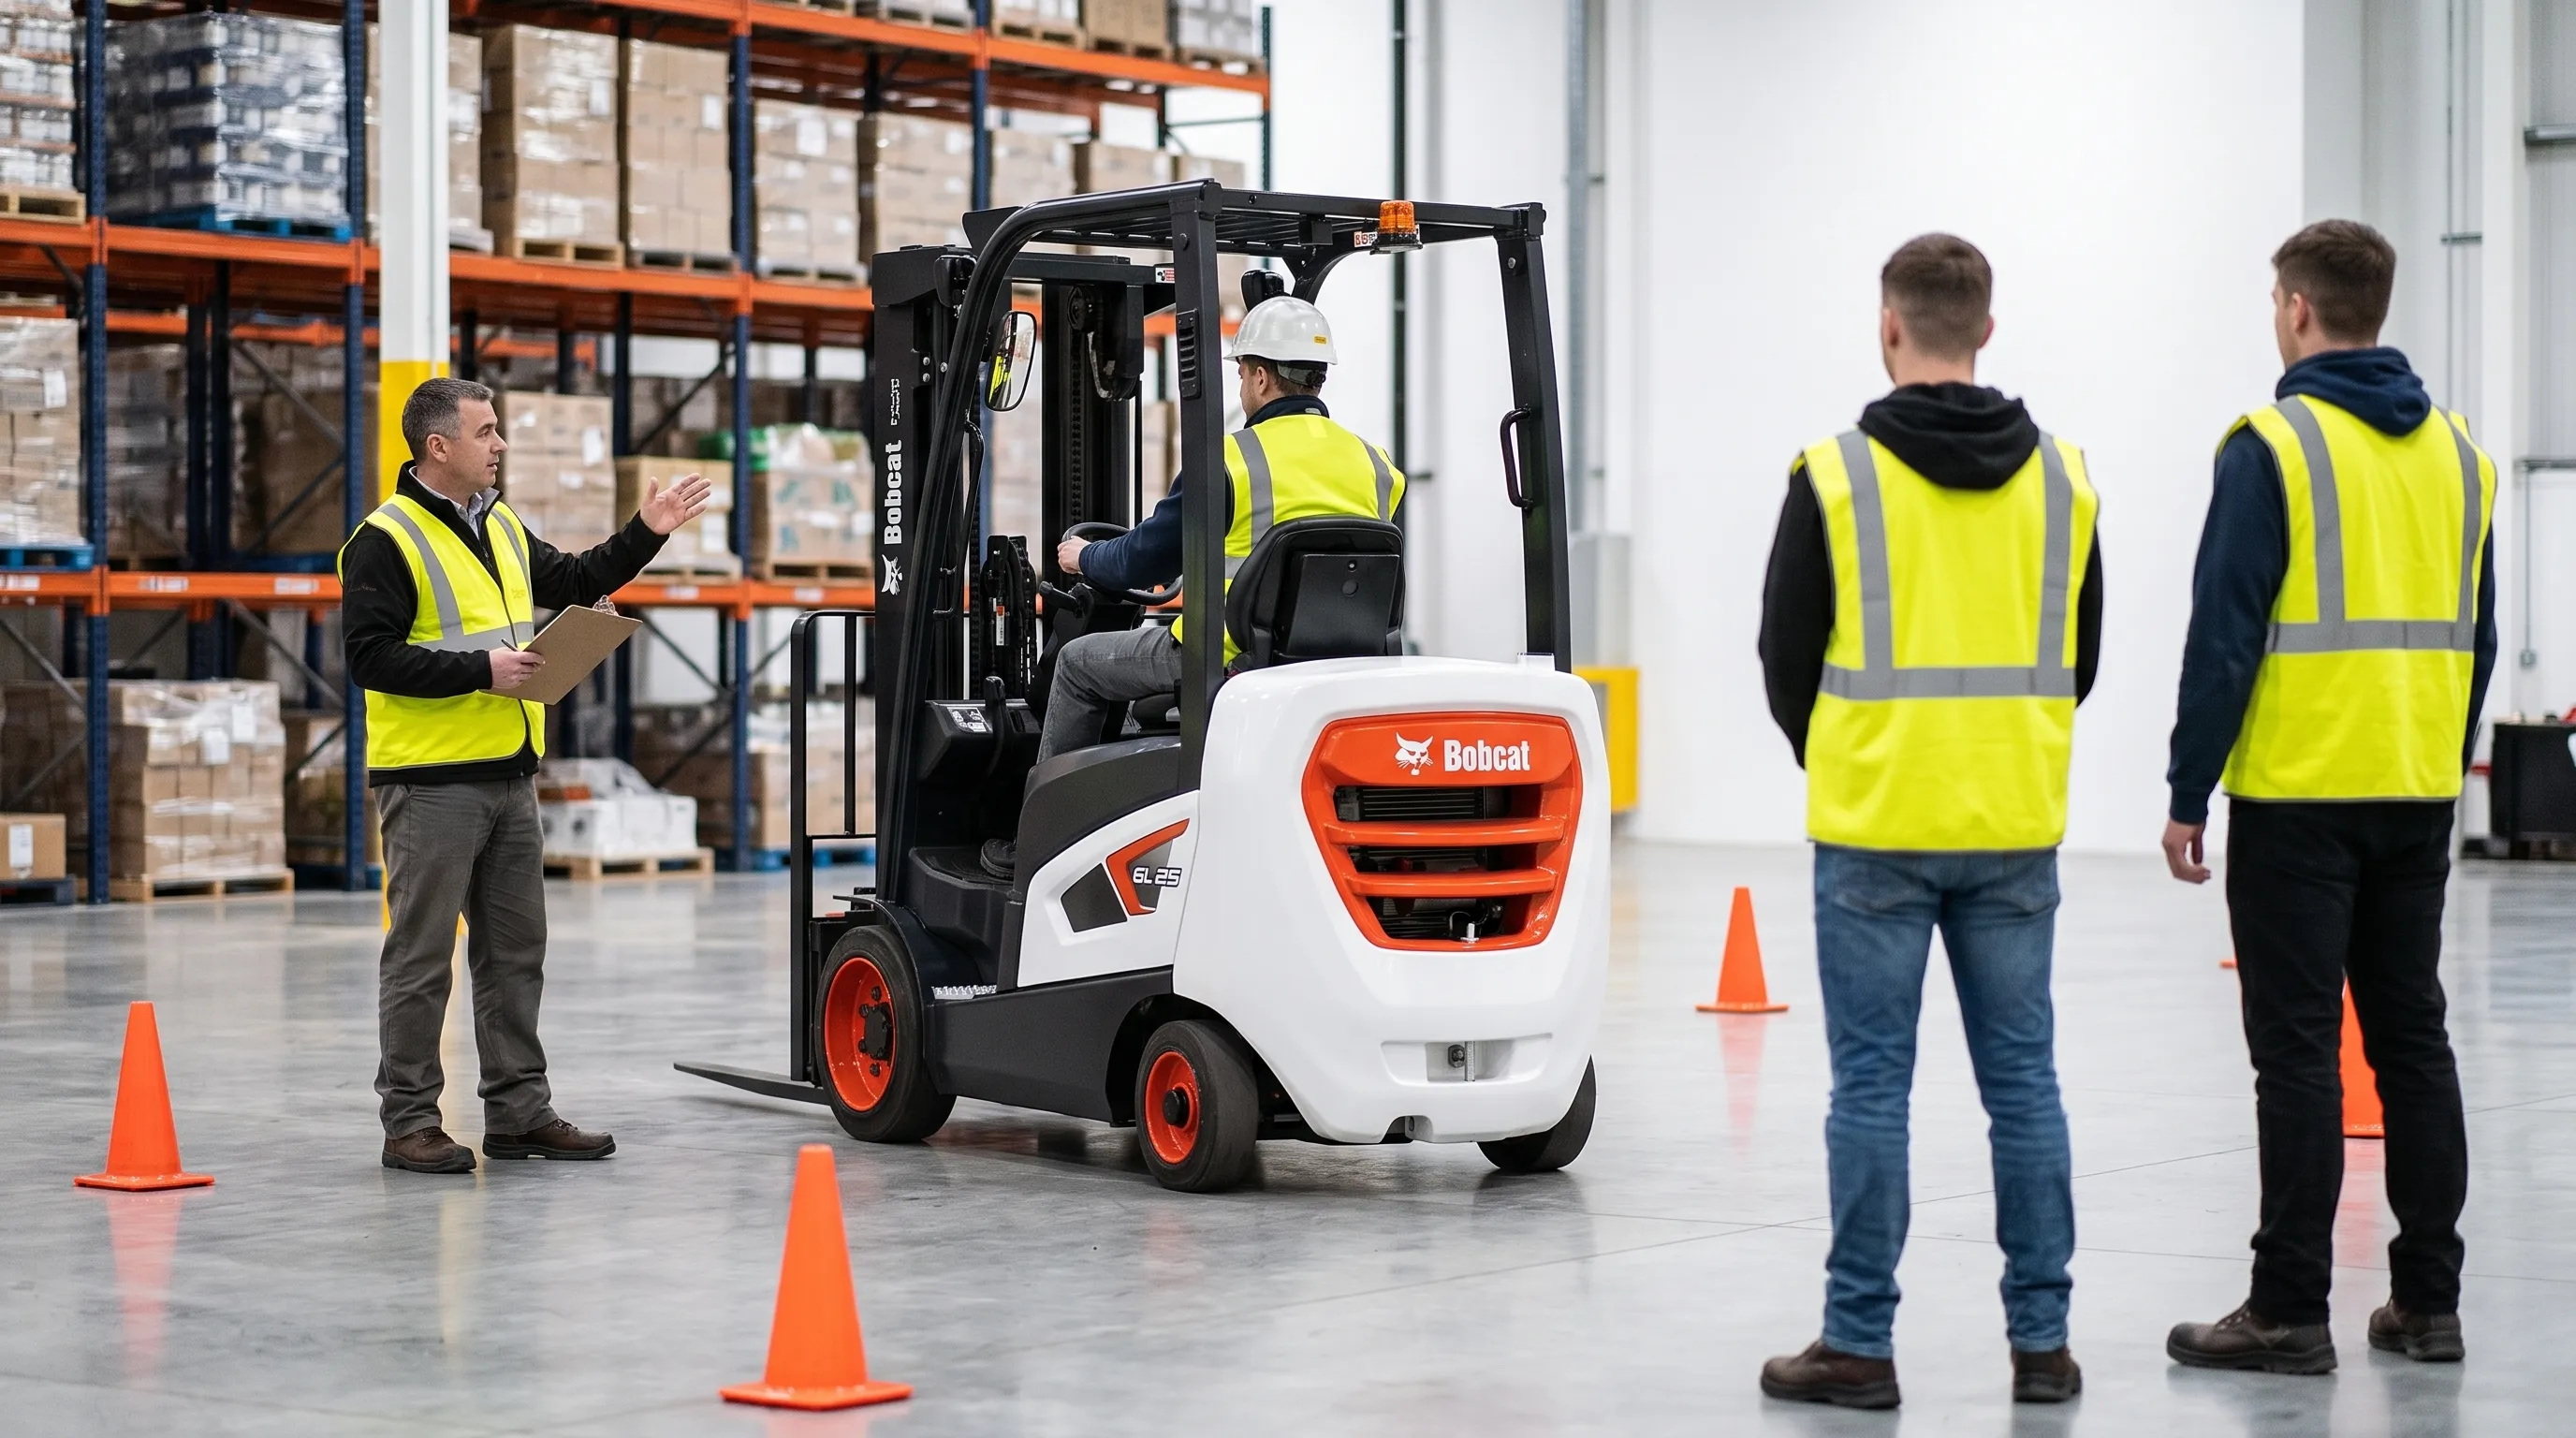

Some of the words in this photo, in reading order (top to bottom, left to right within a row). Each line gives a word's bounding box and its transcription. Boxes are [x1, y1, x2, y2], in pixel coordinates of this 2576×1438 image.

[884, 439, 902, 545] Bobcat
[1443, 740, 1530, 772] Bobcat
[1154, 867, 1181, 887] 25
